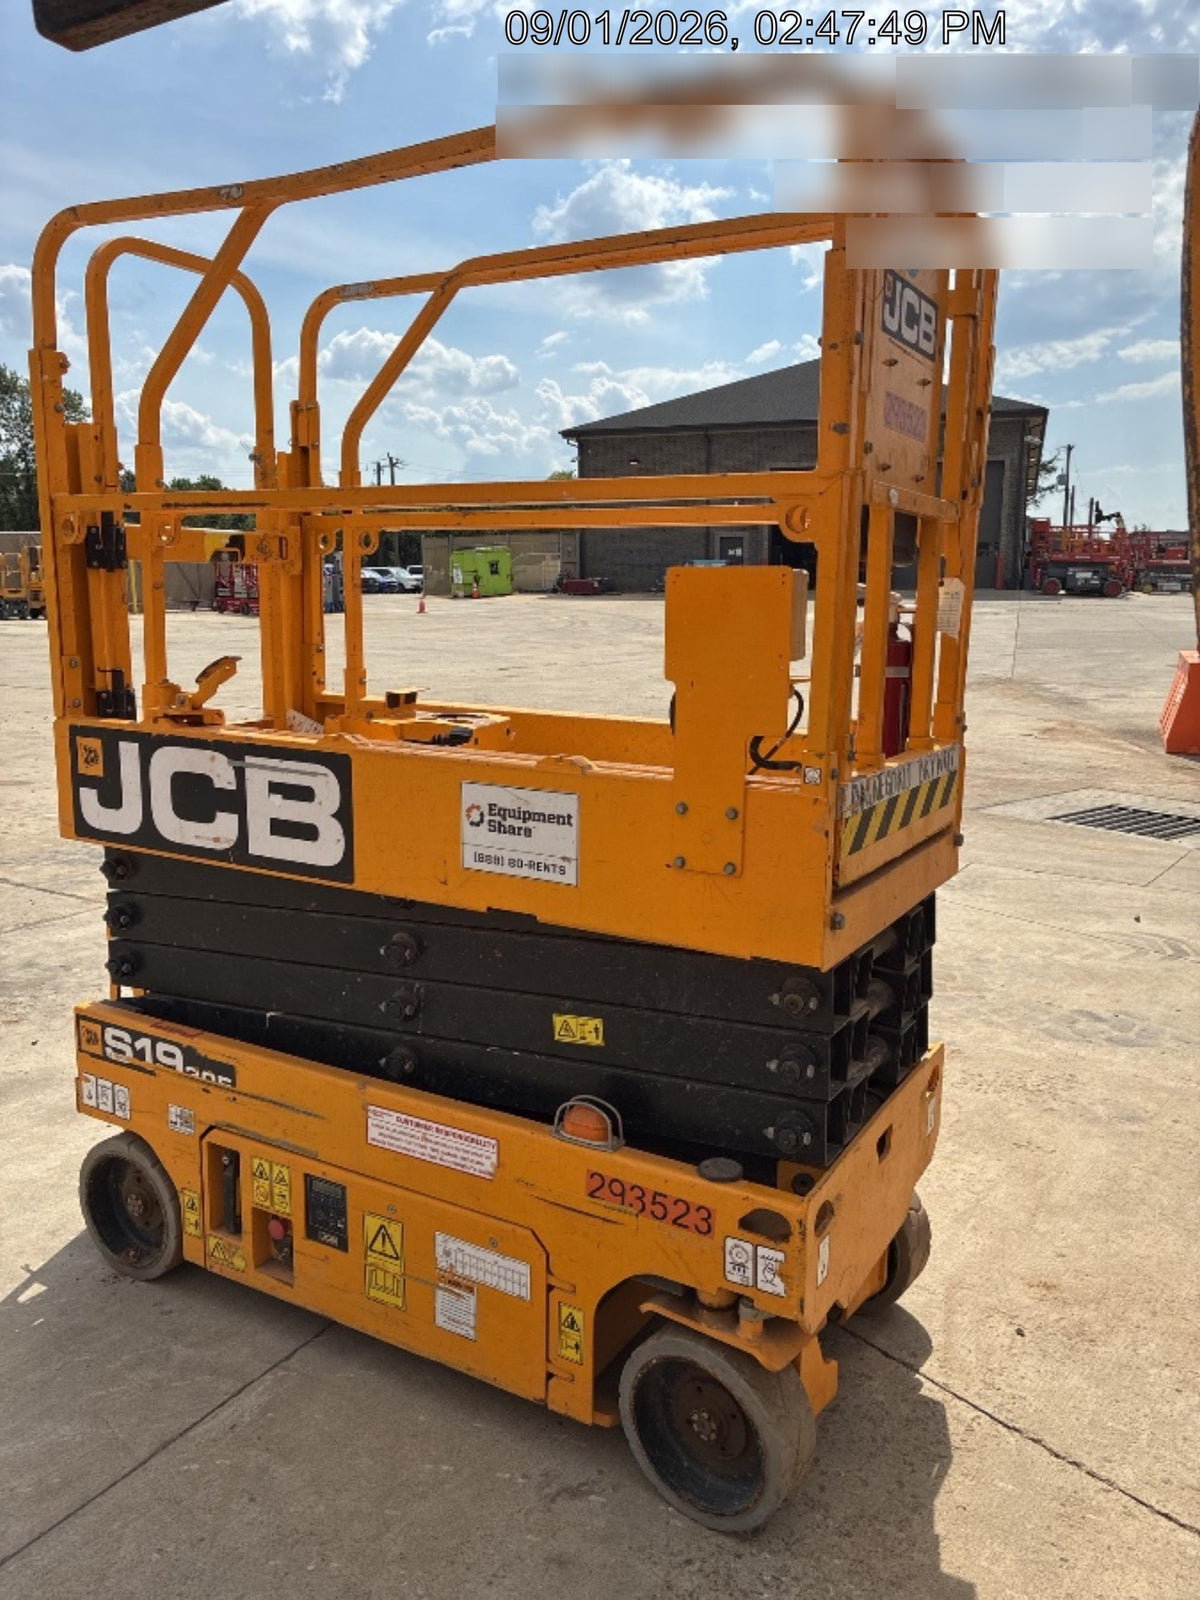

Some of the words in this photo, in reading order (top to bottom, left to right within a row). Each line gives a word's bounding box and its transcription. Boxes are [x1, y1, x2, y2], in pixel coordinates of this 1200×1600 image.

[883, 280, 937, 355] JCB
[79, 740, 346, 867] JCB
[487, 802, 573, 828] Equipment
[487, 819, 533, 838] Share
[103, 1026, 184, 1073] S19
[588, 1171, 713, 1236] 293523
